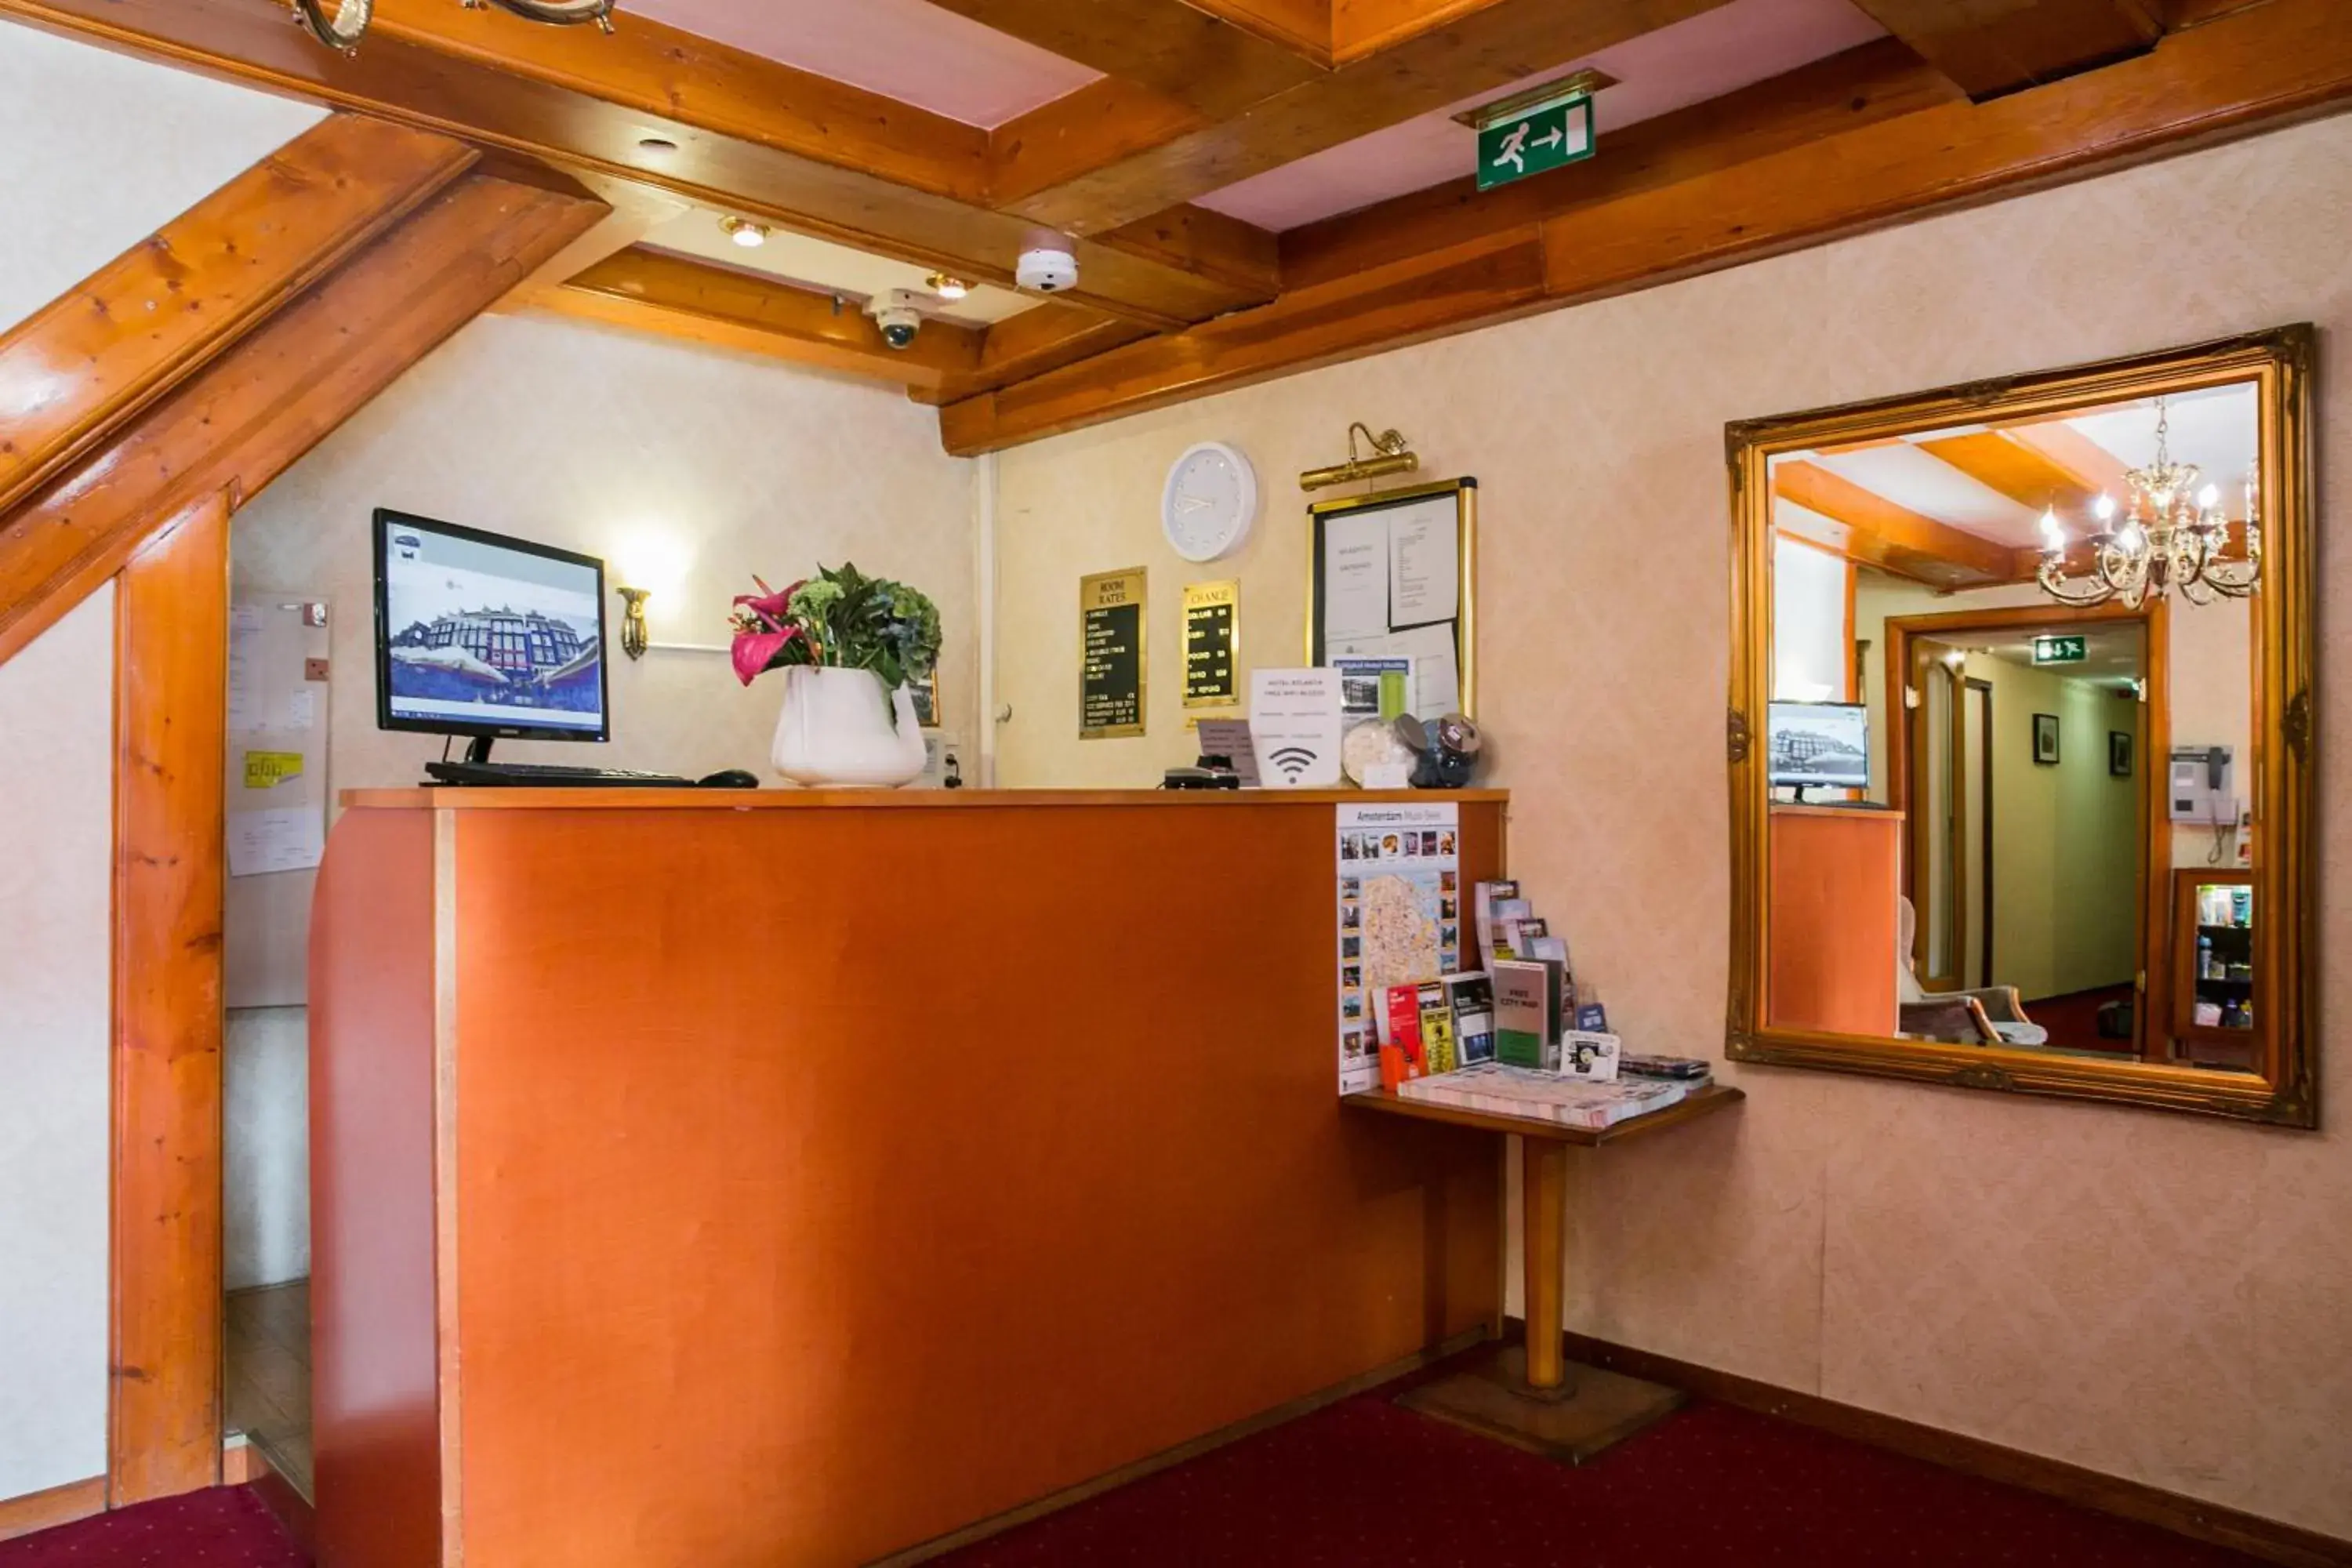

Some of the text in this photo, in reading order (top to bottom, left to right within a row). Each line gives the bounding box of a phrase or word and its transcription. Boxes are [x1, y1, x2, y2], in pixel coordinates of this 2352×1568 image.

[1100, 579, 1124, 592] ROOM
[1098, 592, 1126, 604] RATES
[1191, 589, 1229, 604] CHANGE
[1357, 810, 1403, 822] Amsterdam
